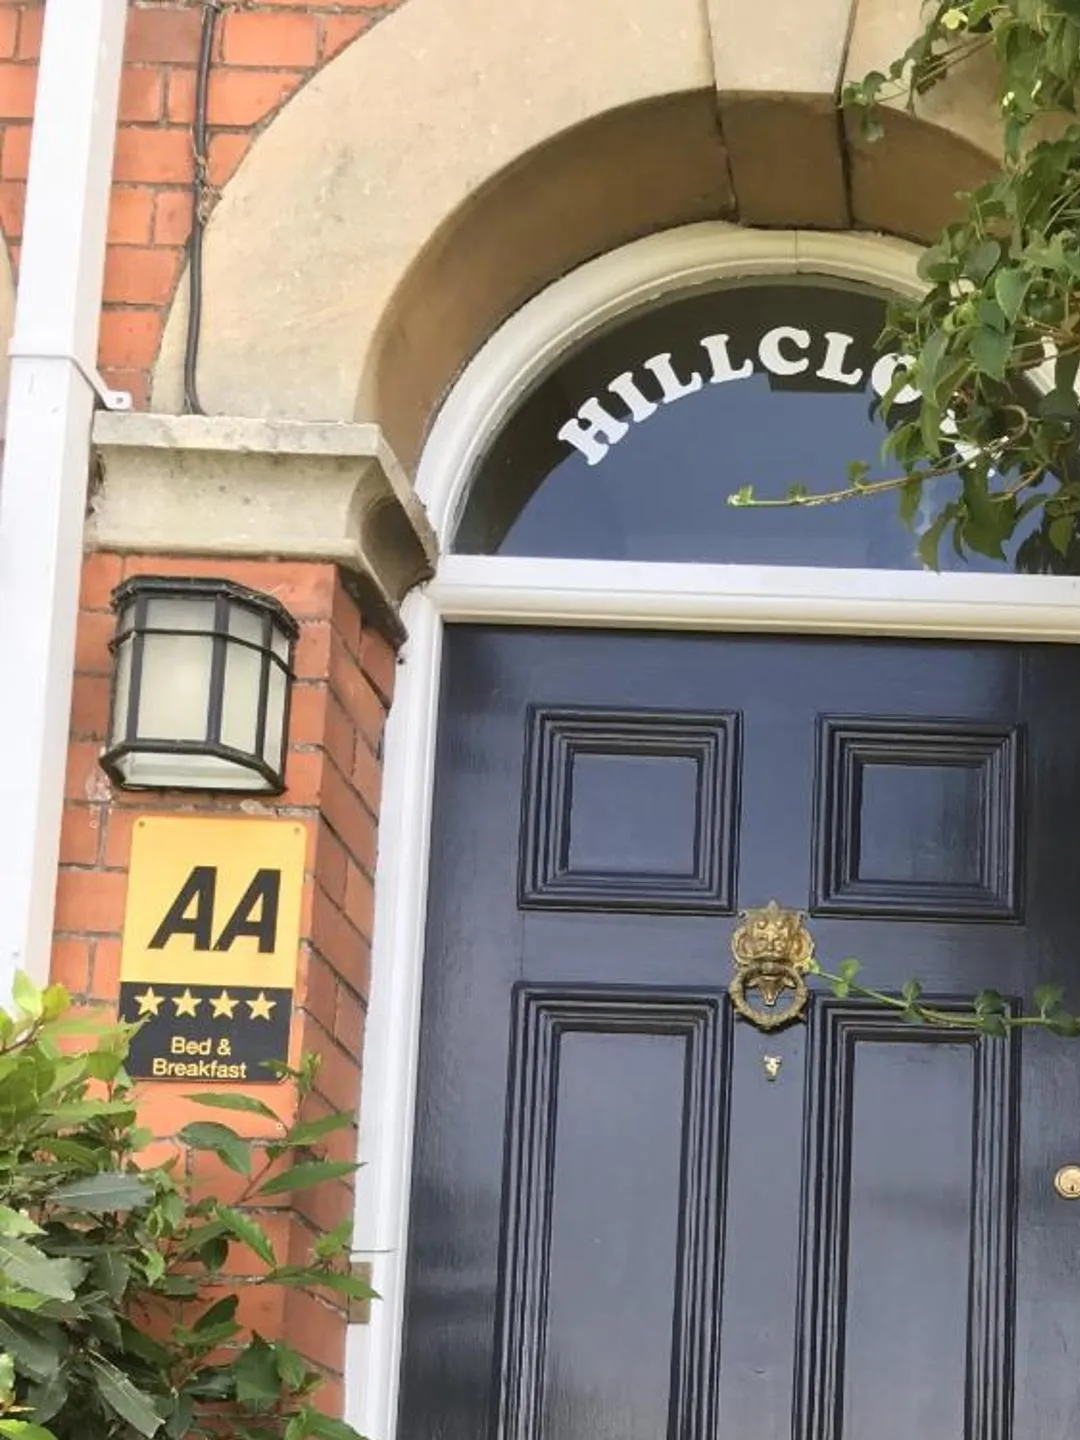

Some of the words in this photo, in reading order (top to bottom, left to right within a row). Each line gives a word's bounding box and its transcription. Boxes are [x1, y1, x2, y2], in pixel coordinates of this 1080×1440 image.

[555, 325, 1010, 478] HILLCLO
[147, 865, 282, 954] AA
[152, 1058, 247, 1079] Breakfast
[170, 1036, 212, 1057] Bed
[216, 1038, 232, 1057] &
